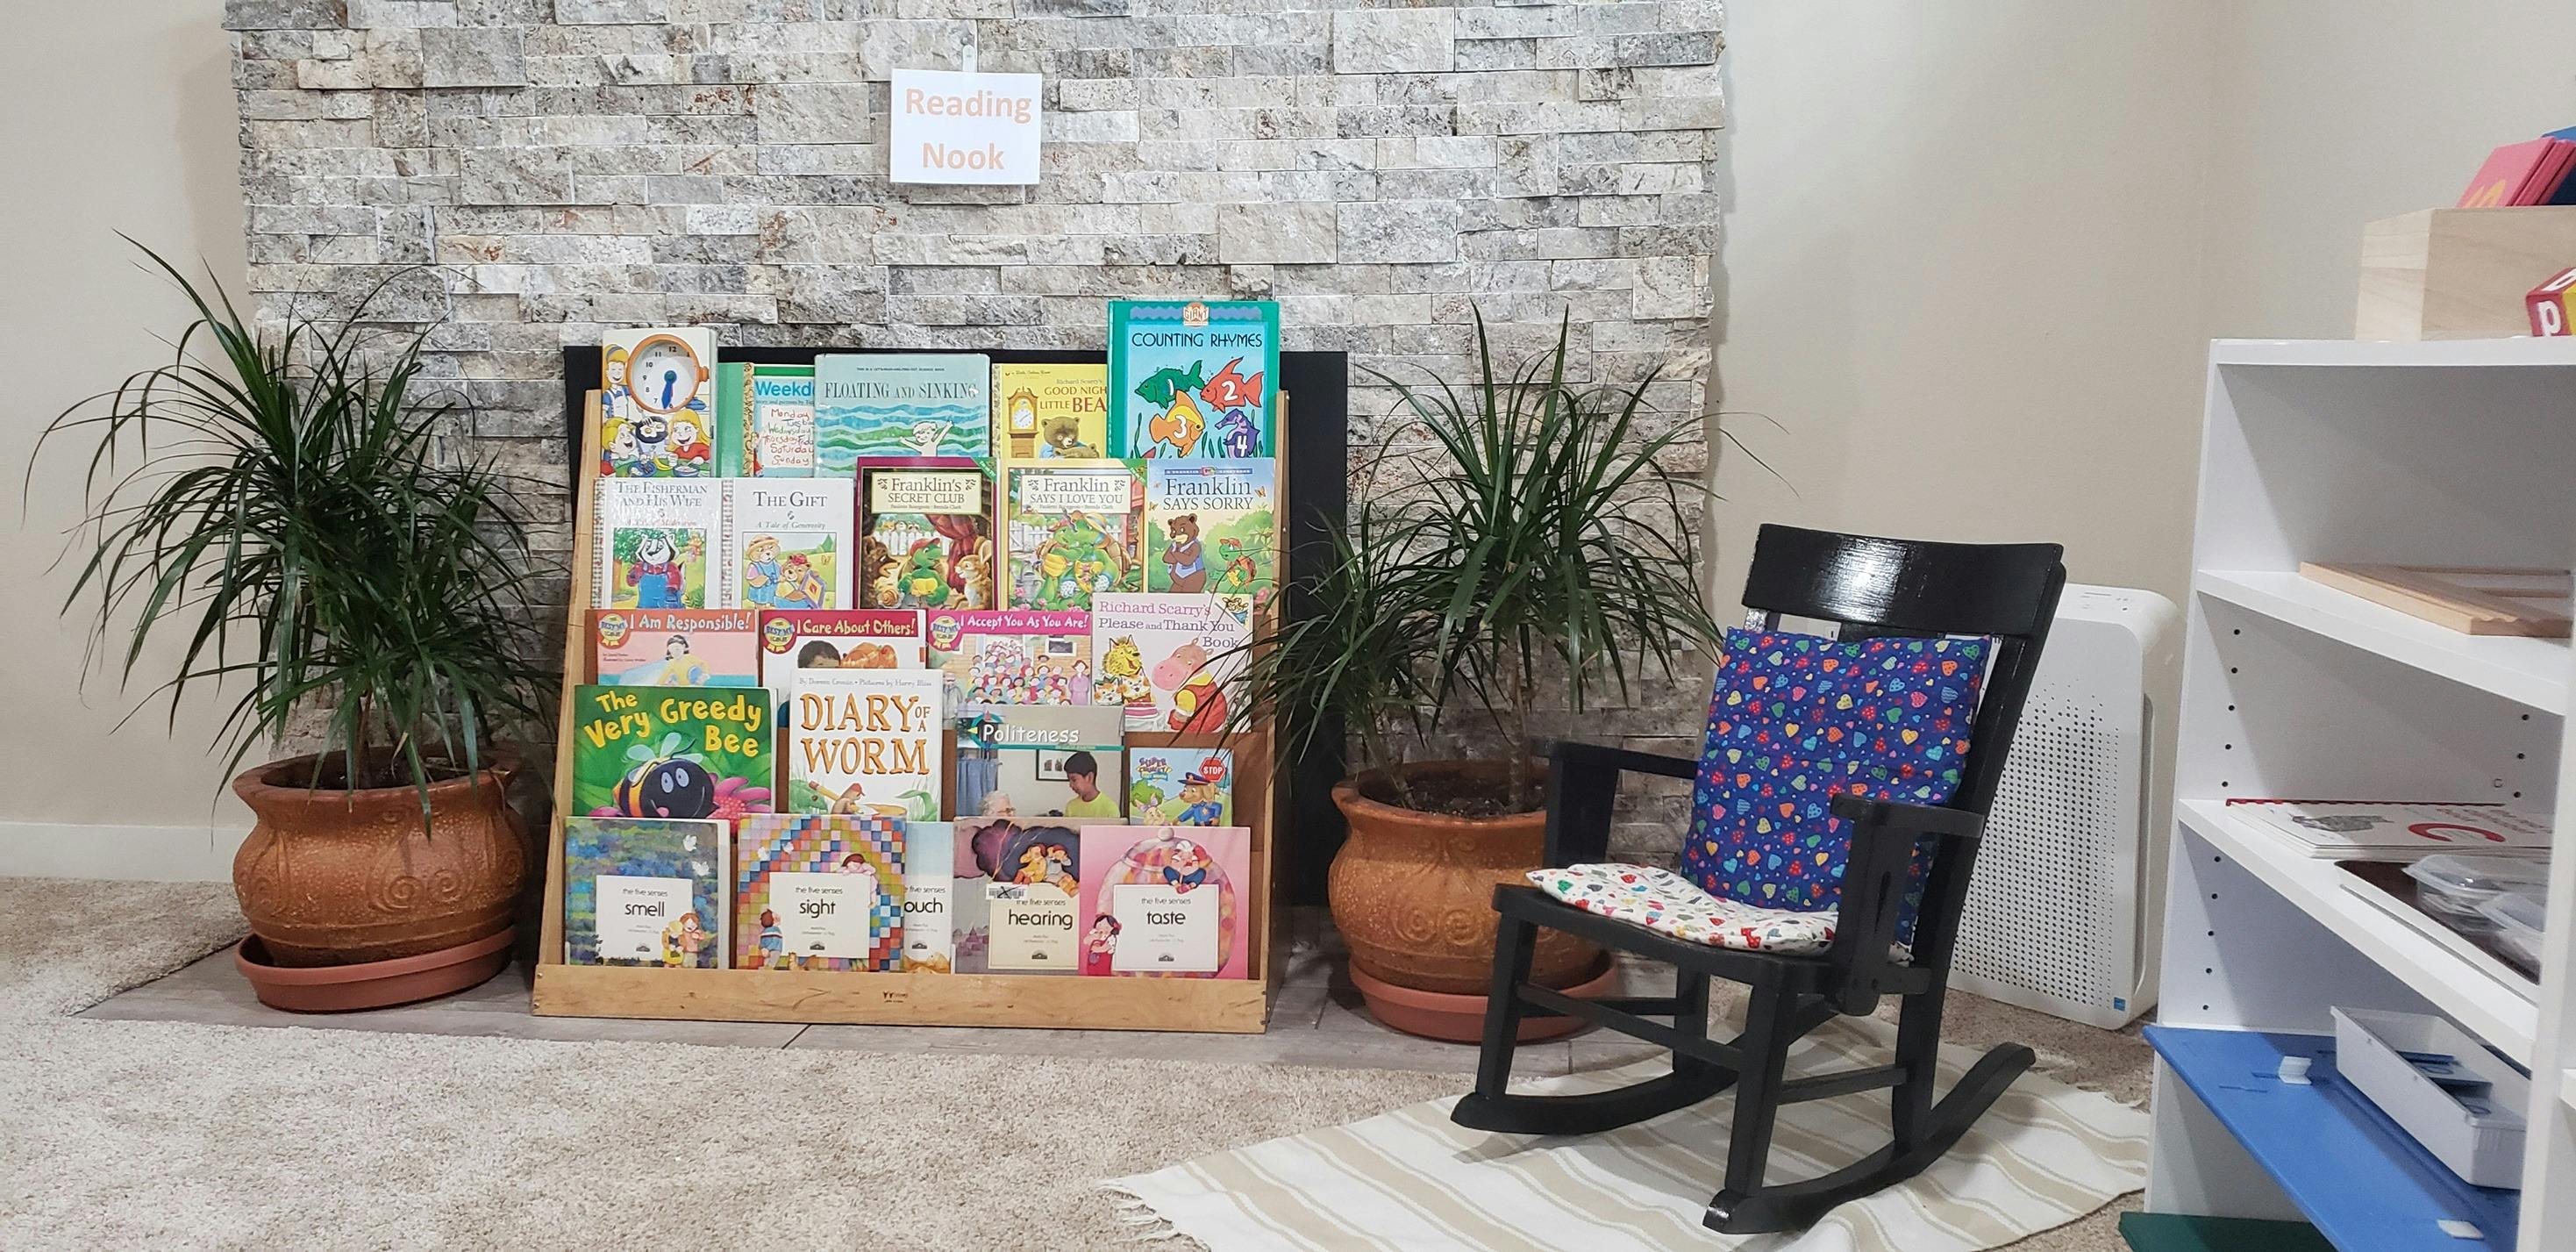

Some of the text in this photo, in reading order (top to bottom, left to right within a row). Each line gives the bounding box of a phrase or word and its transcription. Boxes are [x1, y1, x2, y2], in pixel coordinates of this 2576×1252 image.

[906, 89, 1031, 124] Reading
[923, 143, 1004, 169] Nook
[1184, 307, 1209, 320] GIANT
[1131, 333, 1262, 347] COUNTING RHYMES
[755, 381, 814, 397] Weekd
[825, 383, 976, 399] FLOATING AND SINKING
[1044, 386, 1108, 395] GOOD NIGH
[1167, 379, 1174, 396] 1
[1221, 380, 1238, 401] 2
[1073, 397, 1108, 412] BEA
[771, 408, 810, 421] Monday
[1173, 414, 1188, 439] 3
[798, 434, 814, 446] Frida
[1236, 435, 1248, 457] 4
[771, 454, 810, 465] Sunday
[615, 482, 639, 493] THE
[892, 477, 961, 492] Franklin's
[1044, 477, 1110, 492] Franklin
[1166, 476, 1252, 496] Franklin
[670, 494, 702, 506] WIFE
[753, 491, 828, 506] THE GIFT
[888, 492, 965, 504] SECRET CLUB
[1030, 494, 1123, 504] SAYS I LOVE YOU
[1163, 497, 1253, 510] SAYS SORRY
[1099, 601, 1211, 618] Richard Scarry's
[630, 612, 752, 633] I Am Responsible!
[796, 618, 916, 636] I Care About Others!
[960, 614, 1089, 630] I Accept You As You Are!
[1098, 618, 1145, 629] Please
[1163, 619, 1209, 632] Thank
[1210, 620, 1235, 632] You
[1202, 636, 1239, 648] Book
[596, 690, 639, 712] The
[660, 695, 762, 733] Greedy
[800, 693, 919, 733] DIARY
[915, 706, 931, 719] OF
[584, 712, 651, 748] Very
[917, 720, 926, 733] A
[983, 724, 1080, 743] Politeness
[704, 725, 759, 758] Bee
[800, 737, 931, 775] WORM
[624, 901, 665, 918] smell
[799, 898, 837, 919] sight
[904, 898, 943, 914] ouch
[1008, 909, 1074, 930] hearing
[1147, 912, 1186, 925] taste
